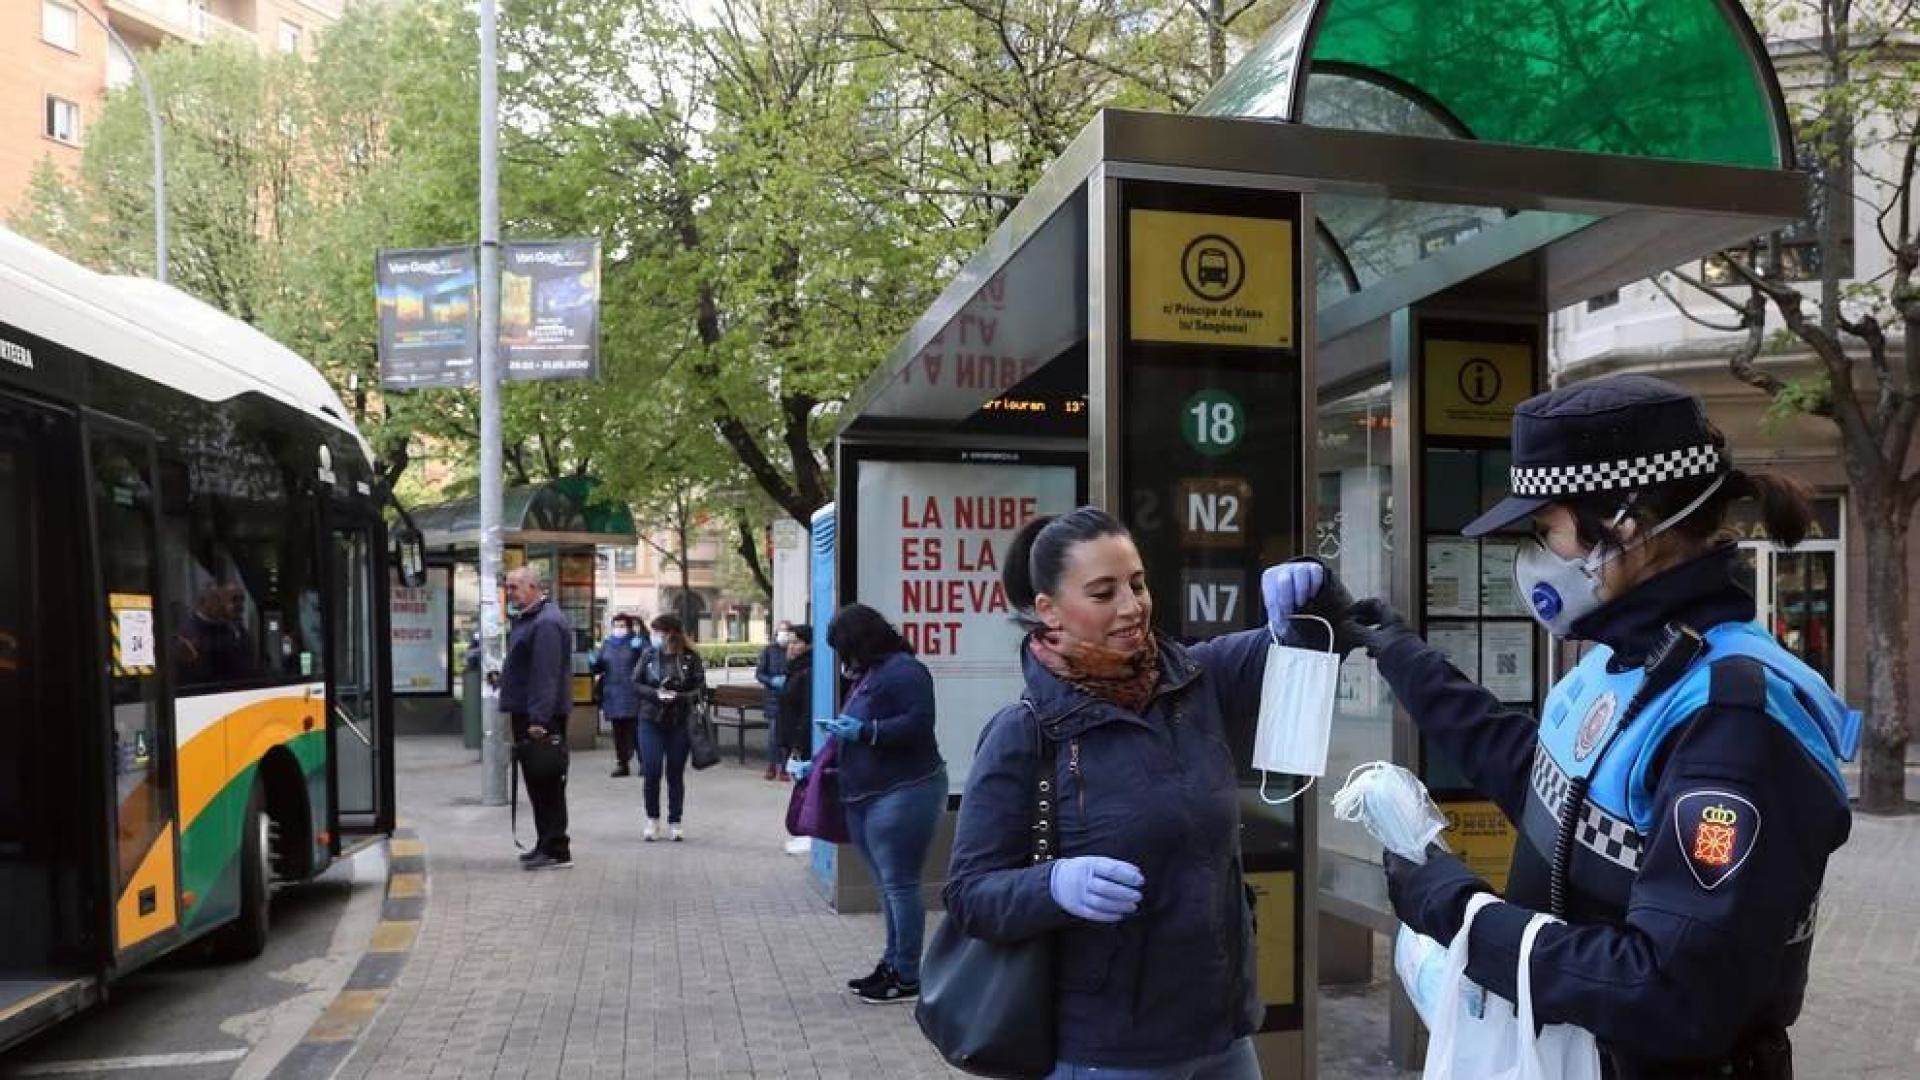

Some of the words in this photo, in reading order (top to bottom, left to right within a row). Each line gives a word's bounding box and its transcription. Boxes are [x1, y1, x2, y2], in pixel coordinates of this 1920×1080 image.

[516, 252, 534, 265] Van
[535, 251, 563, 265] Gogh
[1190, 402, 1235, 444] 18
[902, 496, 942, 529] LA
[955, 496, 1037, 530] NUBE
[1188, 493, 1239, 532] N2
[902, 538, 941, 571] ES
[958, 538, 997, 571] LA
[903, 580, 1008, 613] NUEVA
[1189, 583, 1239, 621] N7
